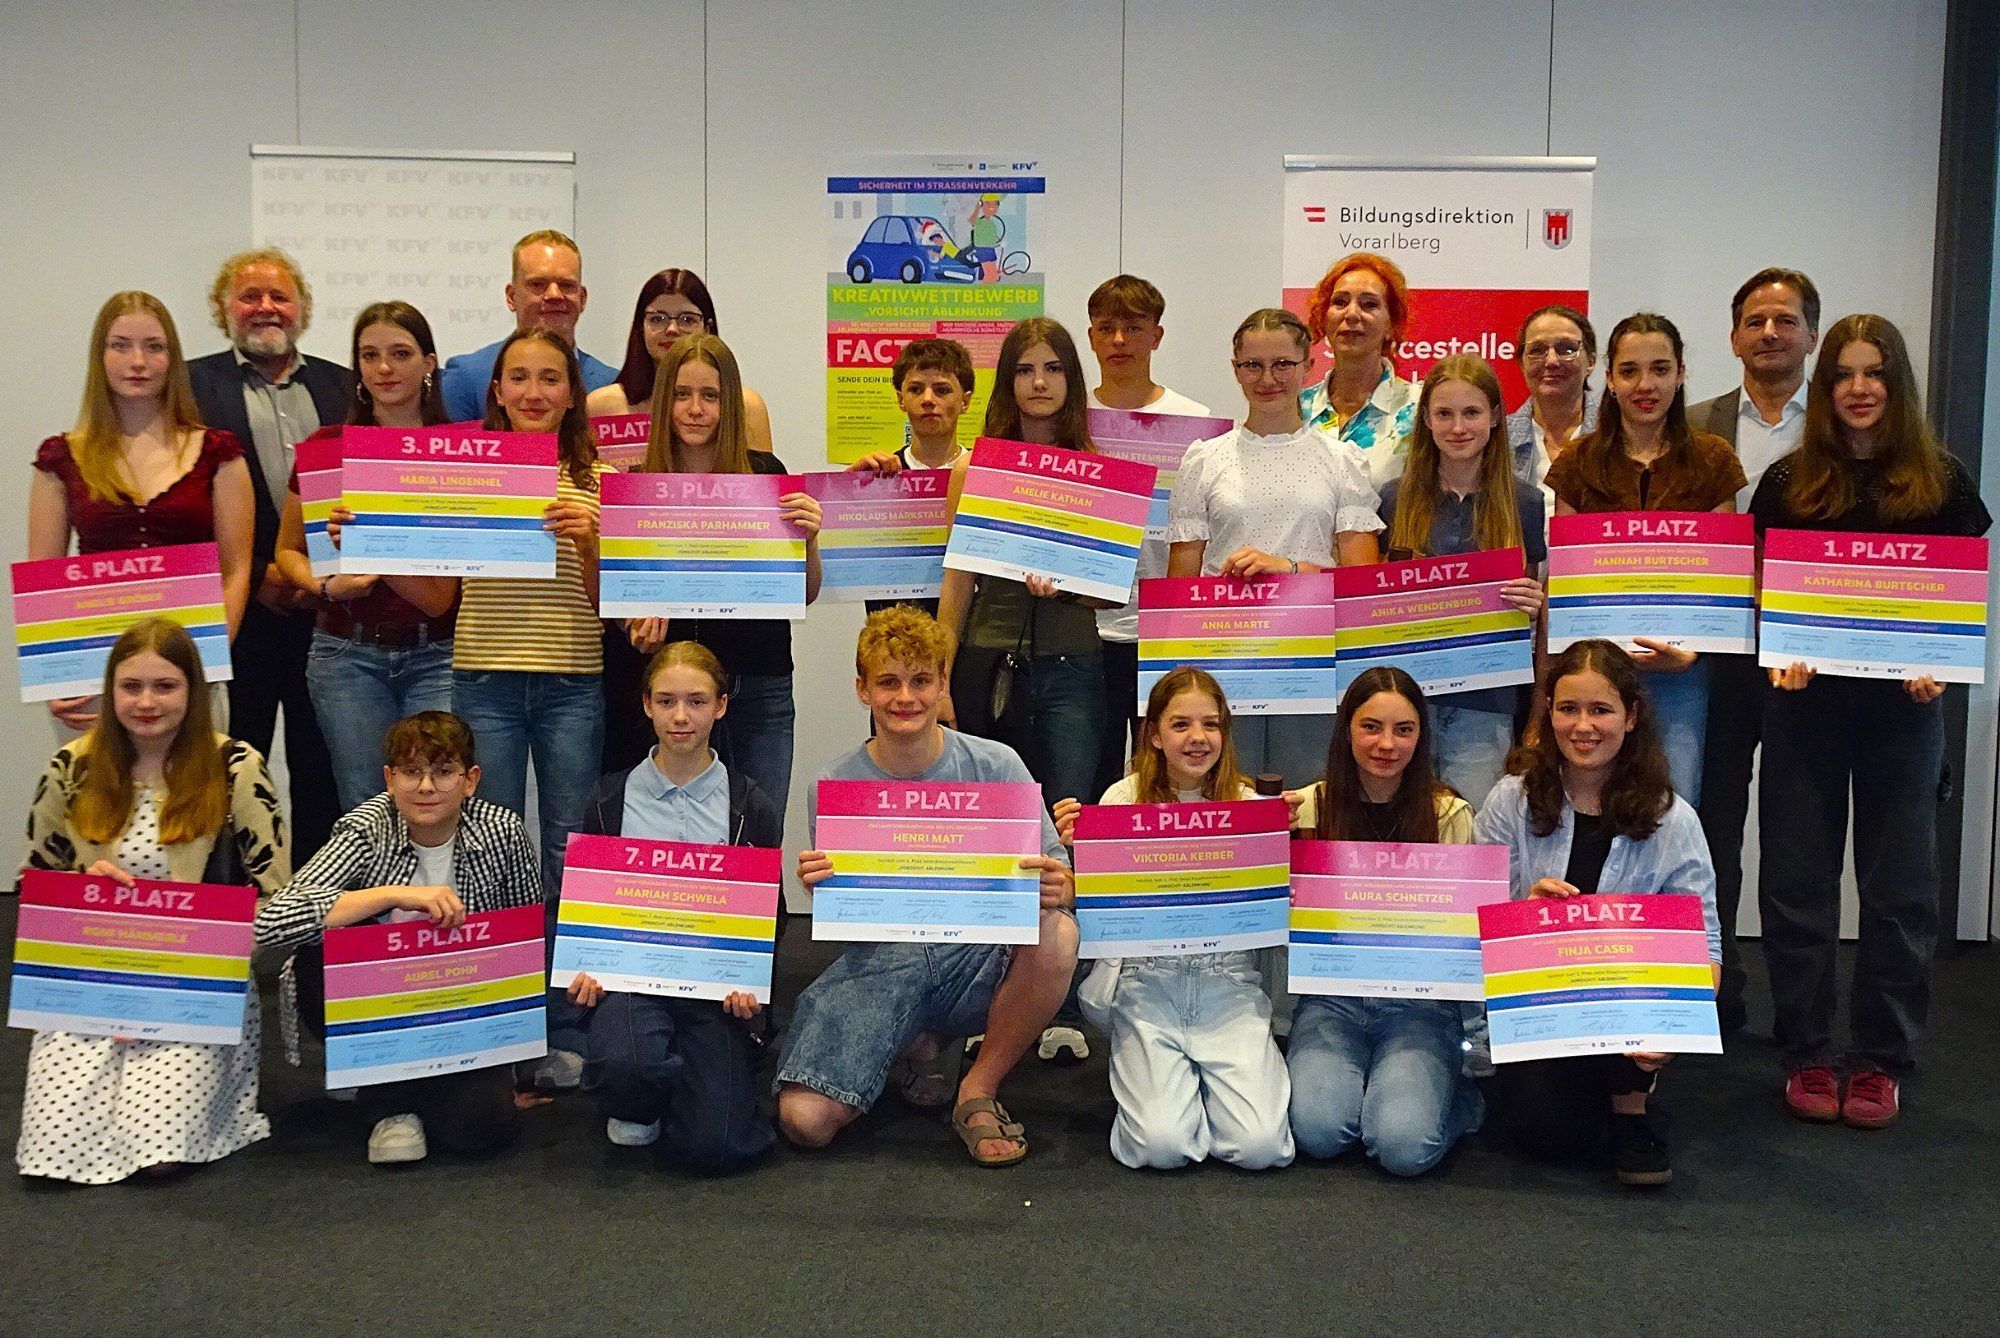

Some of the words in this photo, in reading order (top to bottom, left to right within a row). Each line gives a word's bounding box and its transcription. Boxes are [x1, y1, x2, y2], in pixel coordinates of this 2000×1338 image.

[858, 182, 911, 190] SICHERHEIT
[914, 182, 925, 190] IM
[927, 182, 1017, 190] STRASSENVERKEHR
[1340, 206, 1514, 228] Bildungsdirektion
[1339, 232, 1440, 254] Vorarlberg
[832, 288, 1039, 304] KREATIVWETTBEWERB
[599, 421, 652, 439] PLAT
[401, 436, 423, 455] 3.
[429, 438, 502, 457] PLATZ
[1017, 451, 1033, 468] 1.
[1039, 453, 1104, 480] PLATZ
[400, 475, 438, 485] MARIA
[656, 482, 675, 499] 3.
[682, 482, 751, 500] PLATZ
[1013, 486, 1049, 499] AMELIE
[1051, 492, 1093, 508] KATHAN
[637, 520, 698, 530] FRANZISKA
[701, 521, 771, 531] PARHAMMER
[838, 512, 888, 522] NIKOLAUS
[1602, 520, 1621, 537] 1.
[1628, 519, 1698, 537] PLATZ
[1824, 540, 1844, 558] 1.
[1852, 541, 1928, 561] PLATZ
[66, 564, 88, 581] 6.
[92, 555, 166, 578] PLATZ
[1594, 557, 1640, 566] HANNAH
[1645, 556, 1710, 566] BURTSCHER
[1376, 572, 1395, 588] 1.
[1401, 562, 1470, 586] PLATZ
[1803, 576, 1872, 589] KATHARINA
[1875, 580, 1946, 592] BURTSCHER
[1189, 584, 1207, 601] 1.
[1214, 582, 1280, 601] PLATZ
[1371, 606, 1405, 618] ANIKA
[1407, 598, 1482, 613] WENDENBURG
[1201, 621, 1231, 630] ANNA
[1234, 620, 1270, 629] MARTE
[877, 791, 897, 809] 1.
[905, 790, 981, 811] PLATZ
[1131, 814, 1151, 832] 1.
[1159, 810, 1233, 831] PLATZ
[893, 832, 928, 843] HENRI
[931, 833, 964, 844] MATT
[625, 846, 643, 867] 7.
[652, 849, 725, 873] PLATZ
[1132, 852, 1187, 863] VIKTORIA
[1190, 850, 1234, 861] KERBER
[1348, 851, 1367, 869] 1.
[1376, 851, 1449, 871] PLATZ
[83, 883, 107, 904] 8.
[114, 887, 196, 911] PLATZ
[614, 887, 670, 900] AMARIAH
[672, 891, 727, 905] SCHWELA
[1344, 891, 1382, 902] LAURA
[1386, 892, 1454, 904] SCHNETZER
[1538, 907, 1560, 925] 1.
[1567, 903, 1646, 923] PLATZ
[387, 932, 410, 952] 5.
[417, 921, 491, 949] PLATZ
[1557, 946, 1592, 957] FINJA
[1595, 944, 1635, 954] CASER
[404, 969, 439, 983] AUREL
